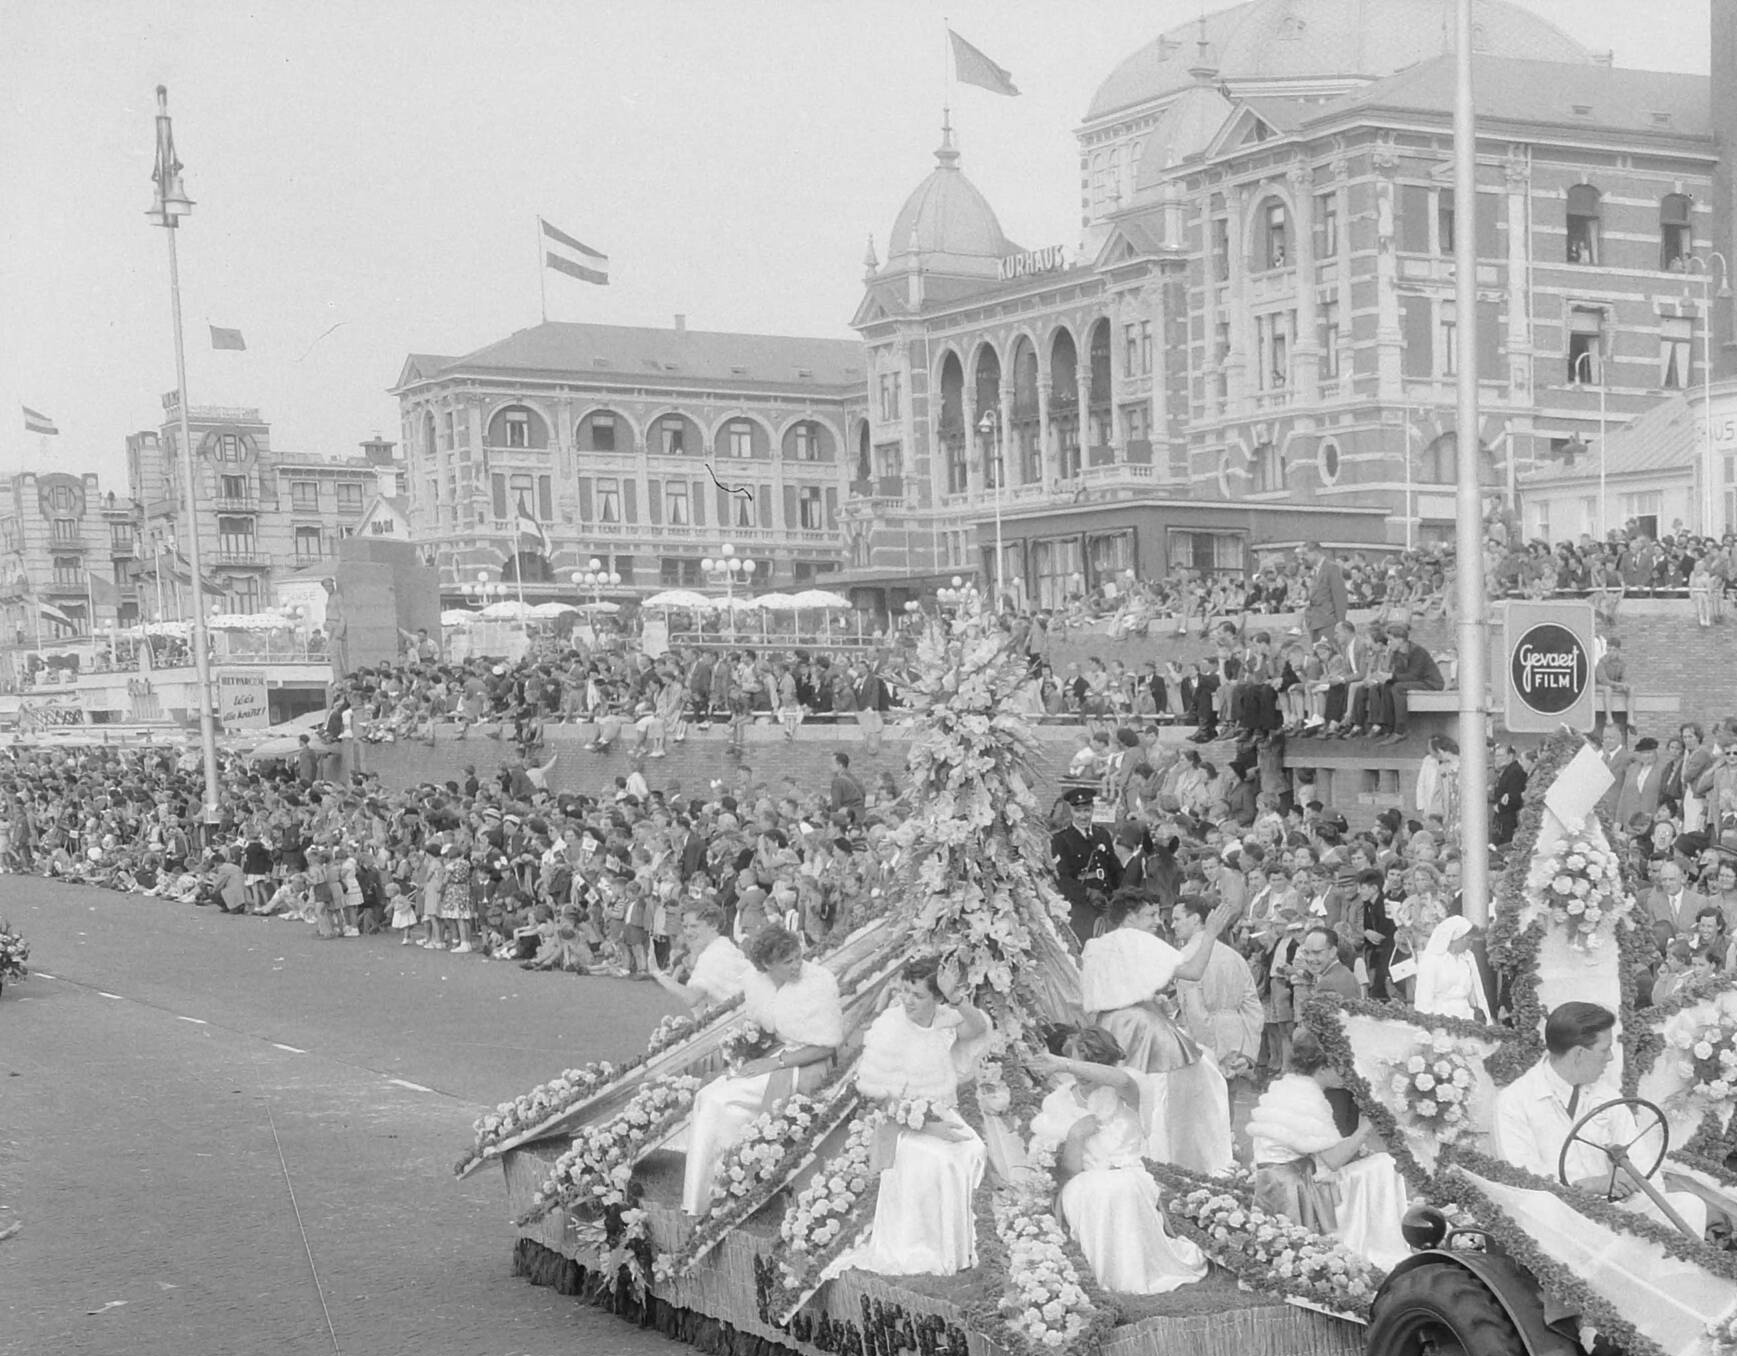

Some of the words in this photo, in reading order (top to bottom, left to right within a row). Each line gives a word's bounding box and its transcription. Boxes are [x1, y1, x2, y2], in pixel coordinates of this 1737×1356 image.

[998, 244, 1064, 281] KURHAUS
[1520, 644, 1580, 694] Gevaert
[1535, 674, 1570, 688] FILM
